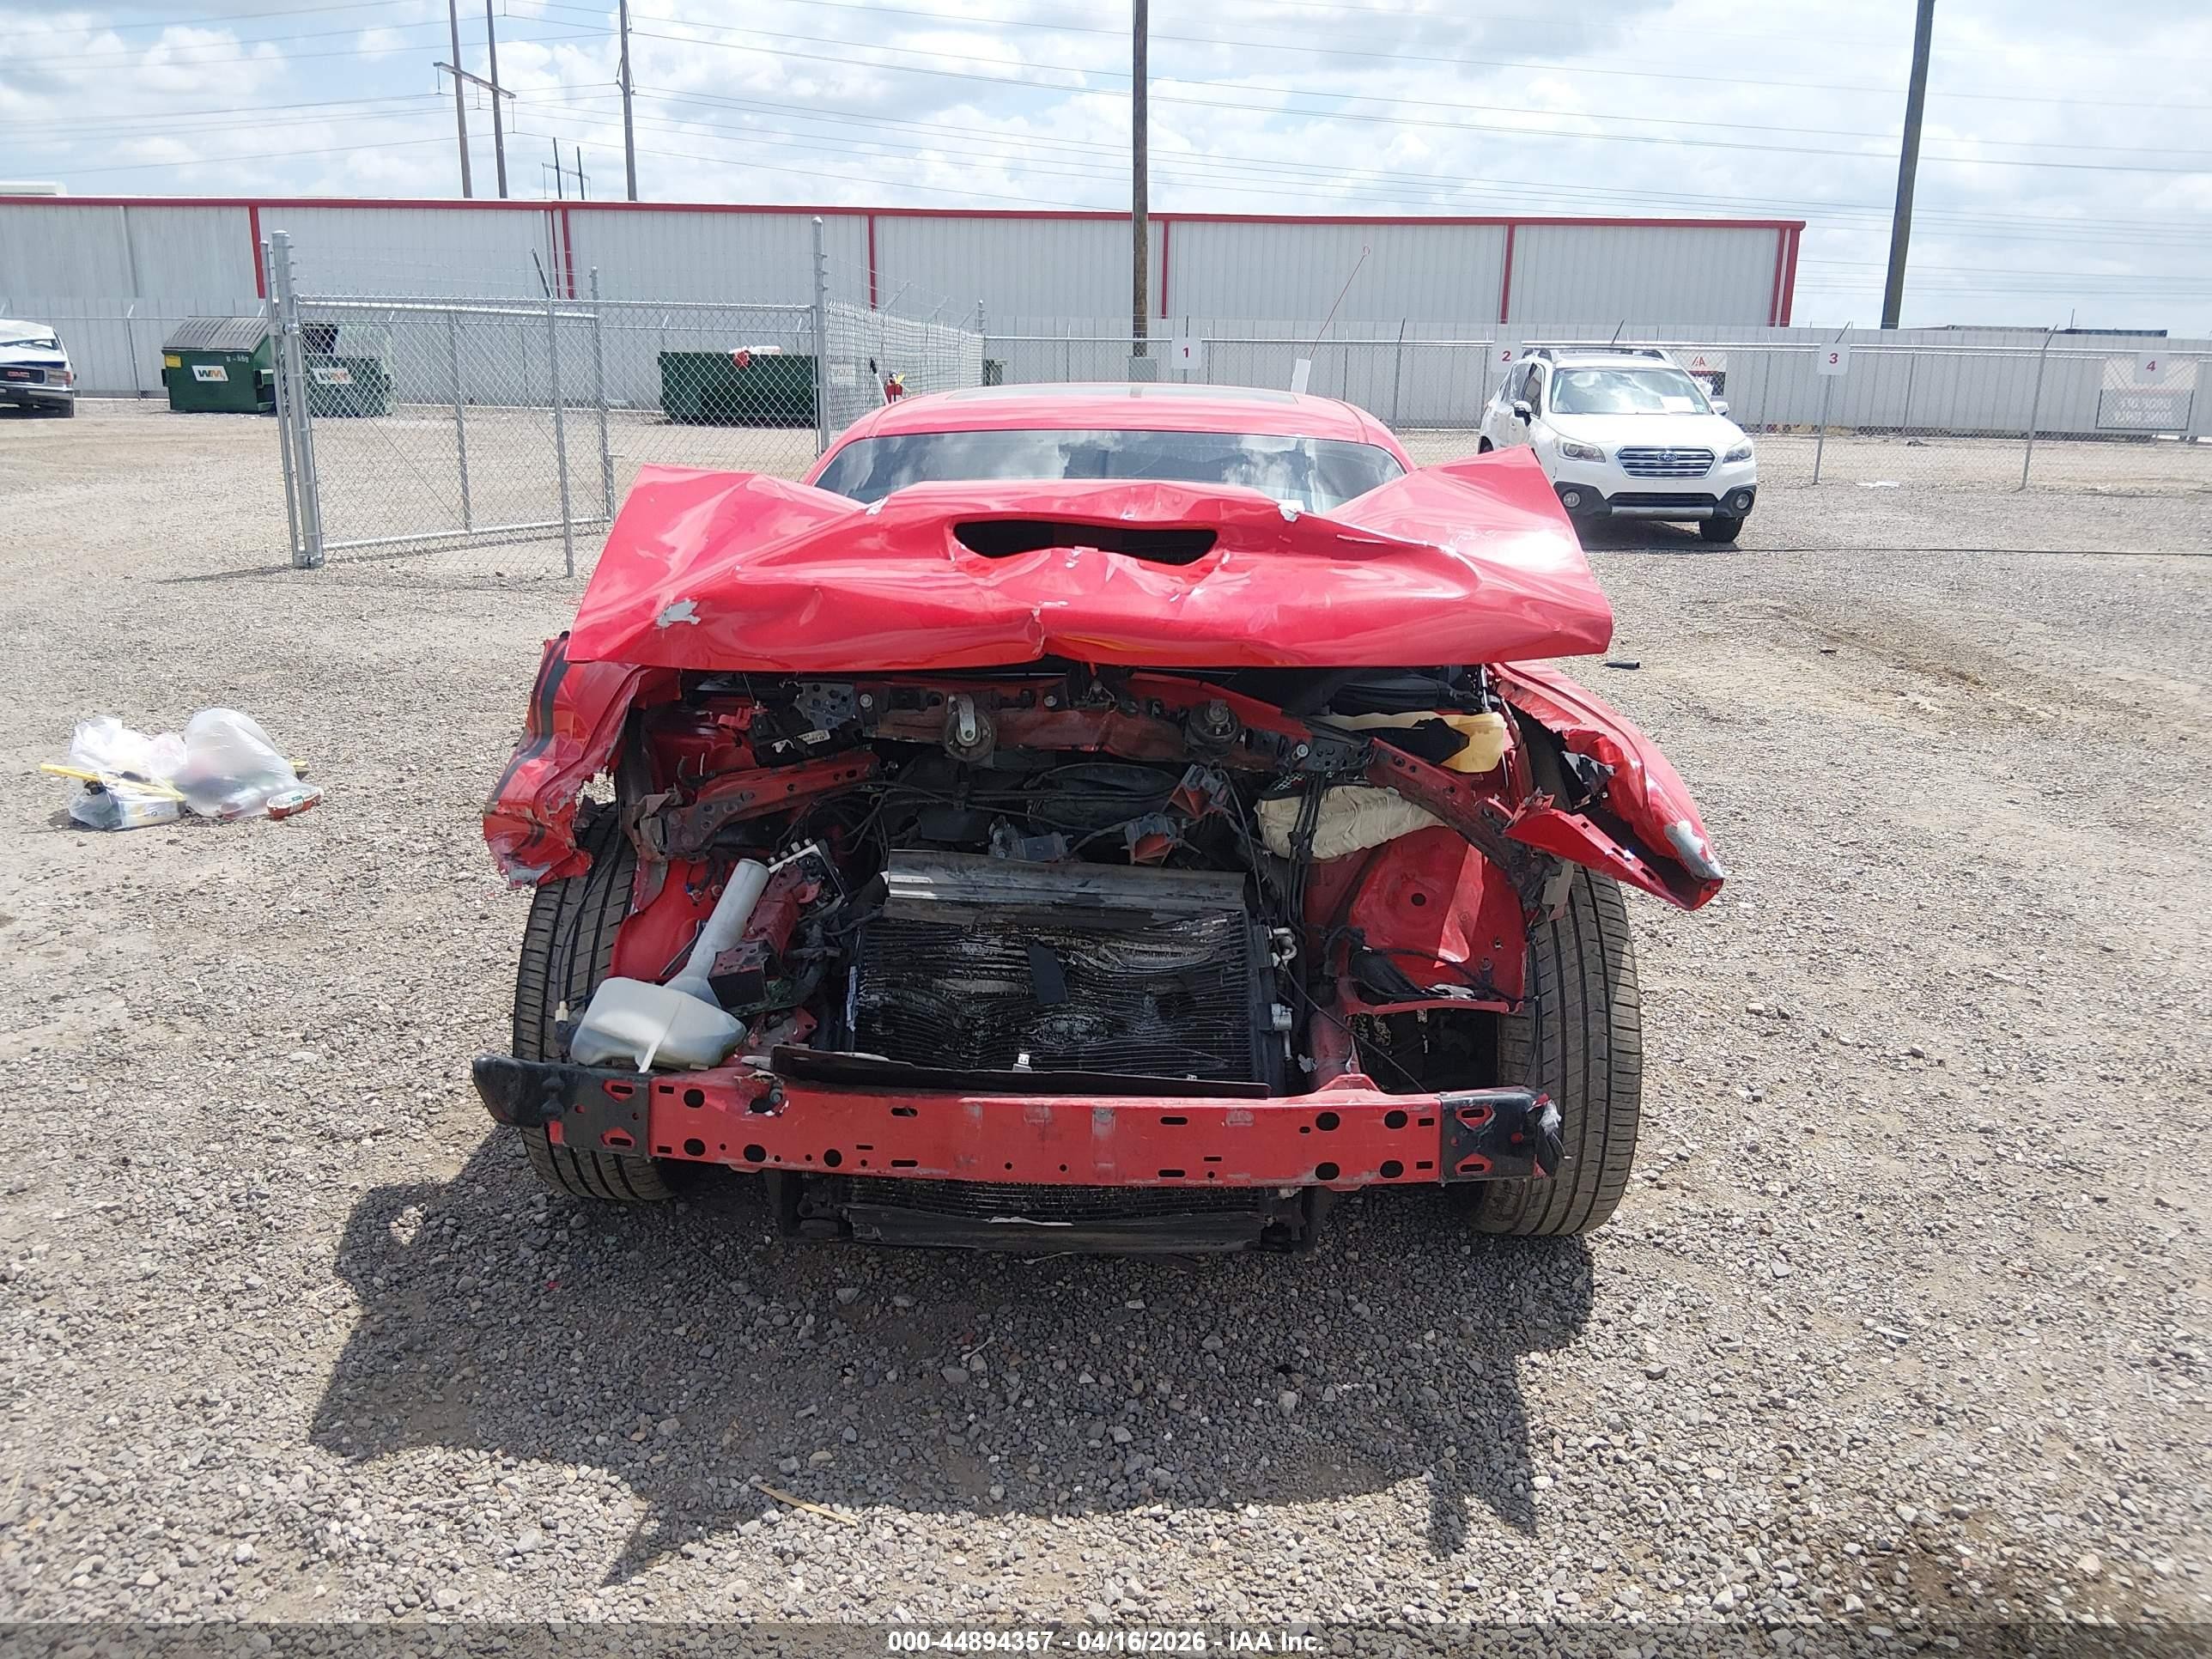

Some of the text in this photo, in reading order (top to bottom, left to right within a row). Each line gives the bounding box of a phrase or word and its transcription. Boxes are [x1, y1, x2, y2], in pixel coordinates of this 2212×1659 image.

[1182, 347, 1189, 358] 1
[1502, 350, 1511, 362] 2
[1829, 352, 1838, 364] 3
[2146, 361, 2156, 372] 4
[198, 369, 224, 378] WM
